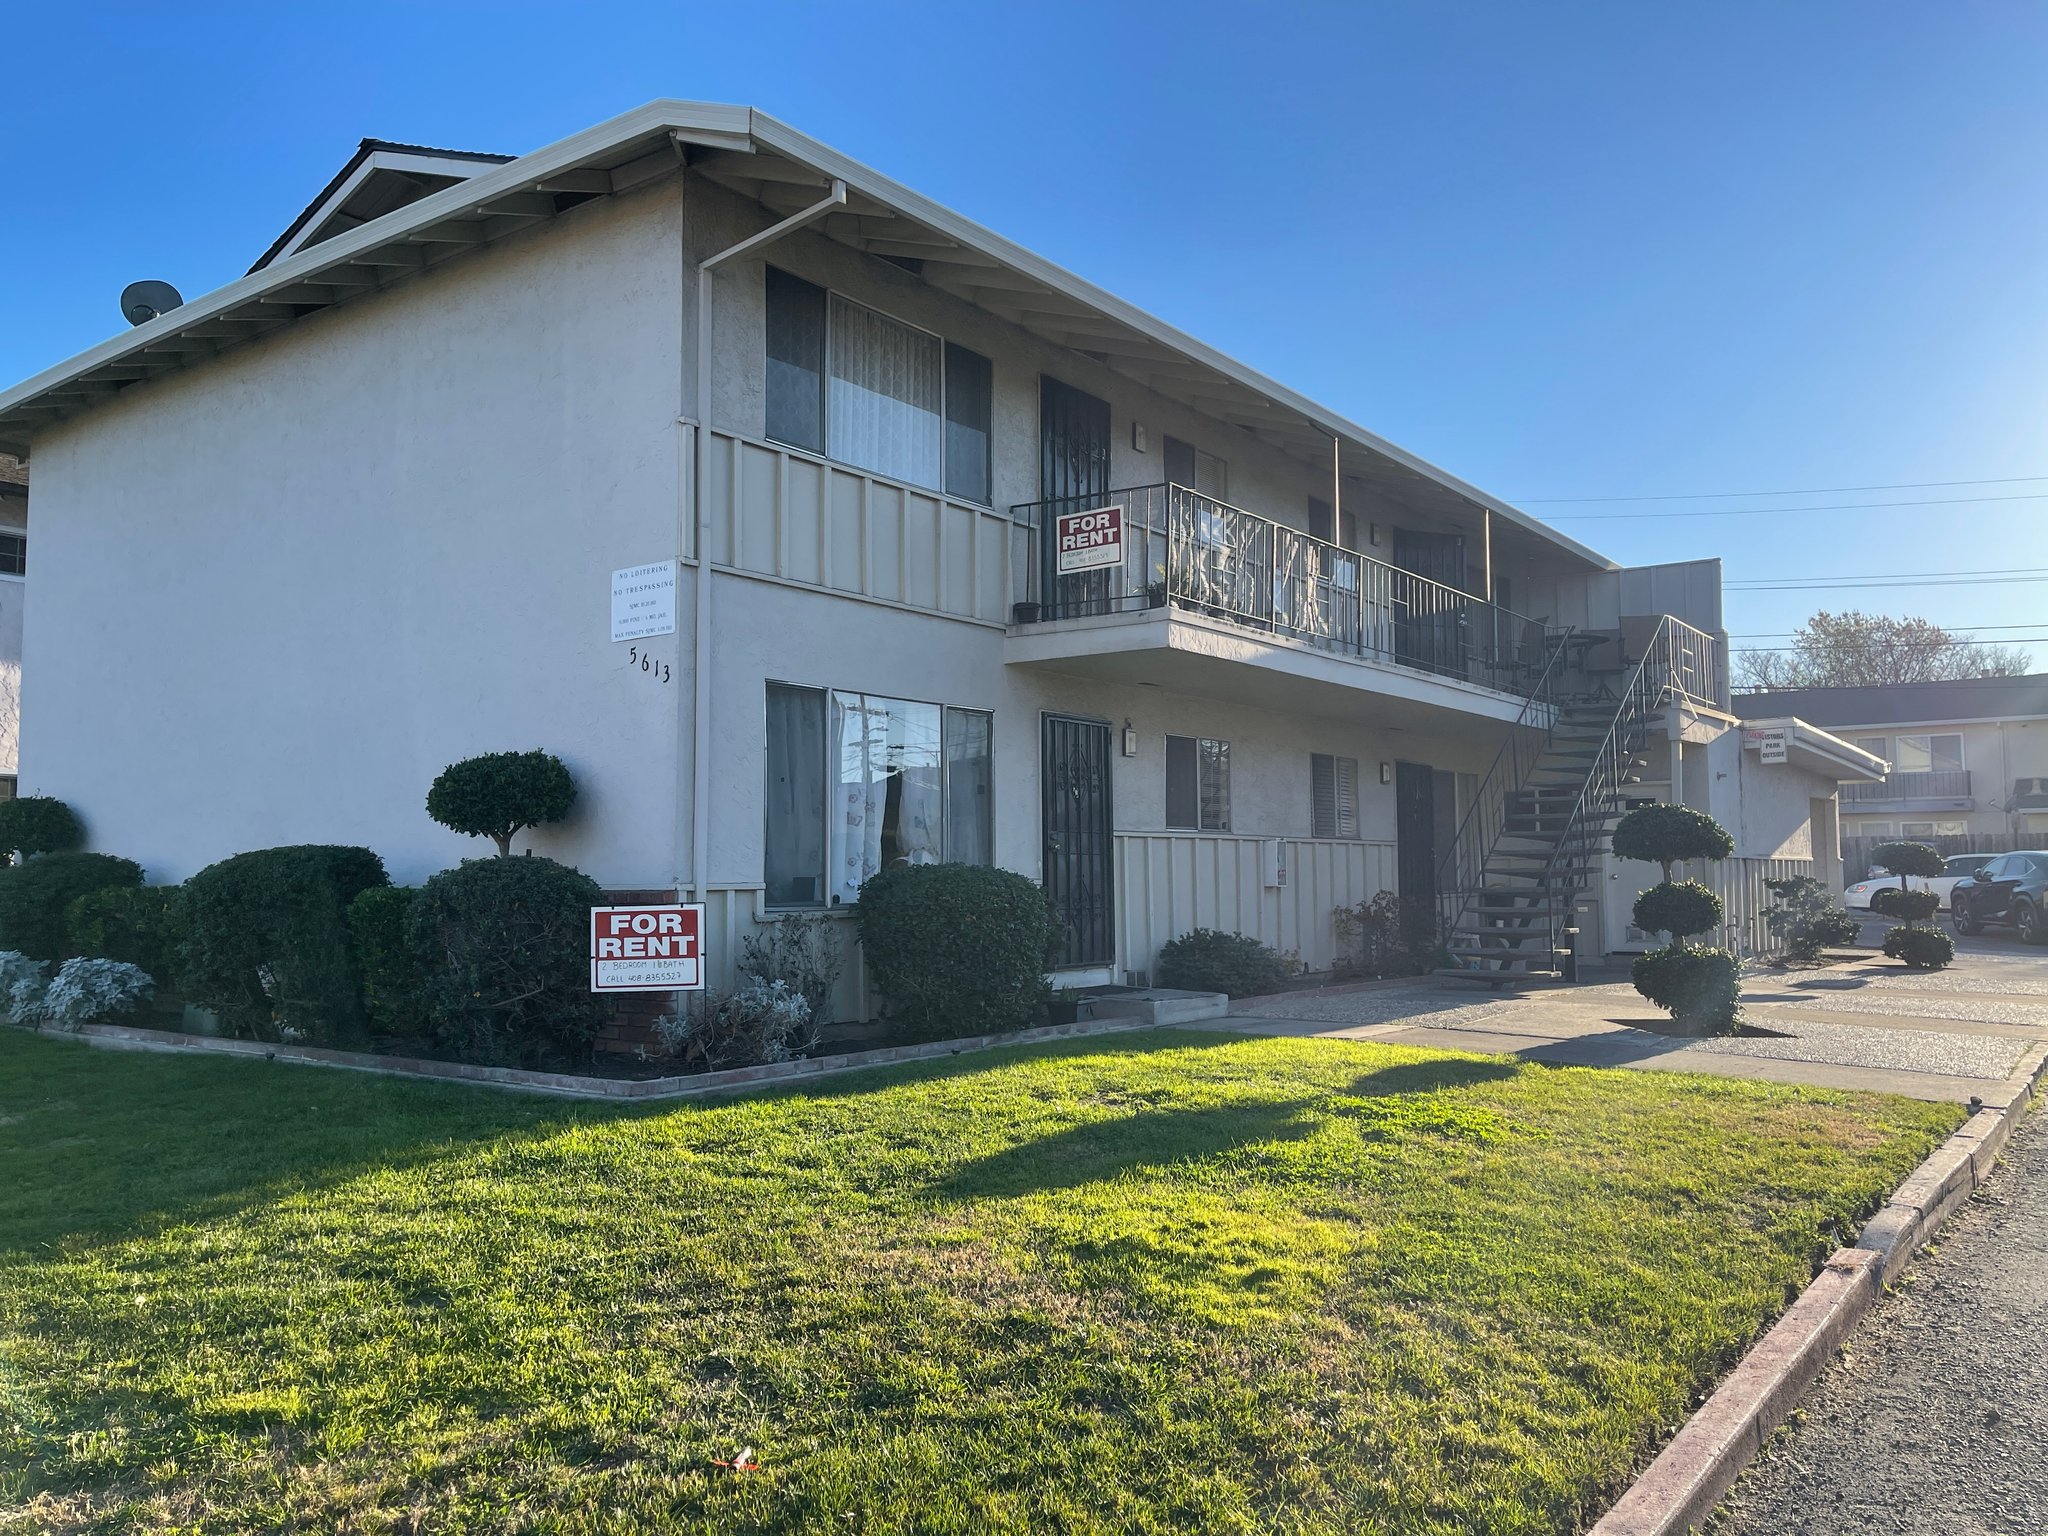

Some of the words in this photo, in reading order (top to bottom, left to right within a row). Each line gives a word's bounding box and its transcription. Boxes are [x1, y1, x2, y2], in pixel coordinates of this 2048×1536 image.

[1068, 513, 1110, 534] FOR
[1062, 527, 1118, 550] RENT
[631, 564, 668, 578] LOITERING
[626, 580, 674, 595] TRESPASSING
[630, 646, 670, 683] 5613
[610, 913, 683, 935] FOR
[598, 935, 695, 958] RENT
[602, 962, 607, 971] 2
[613, 961, 647, 970] BEDROOM
[663, 960, 685, 969] BATH
[606, 975, 624, 983] CALL
